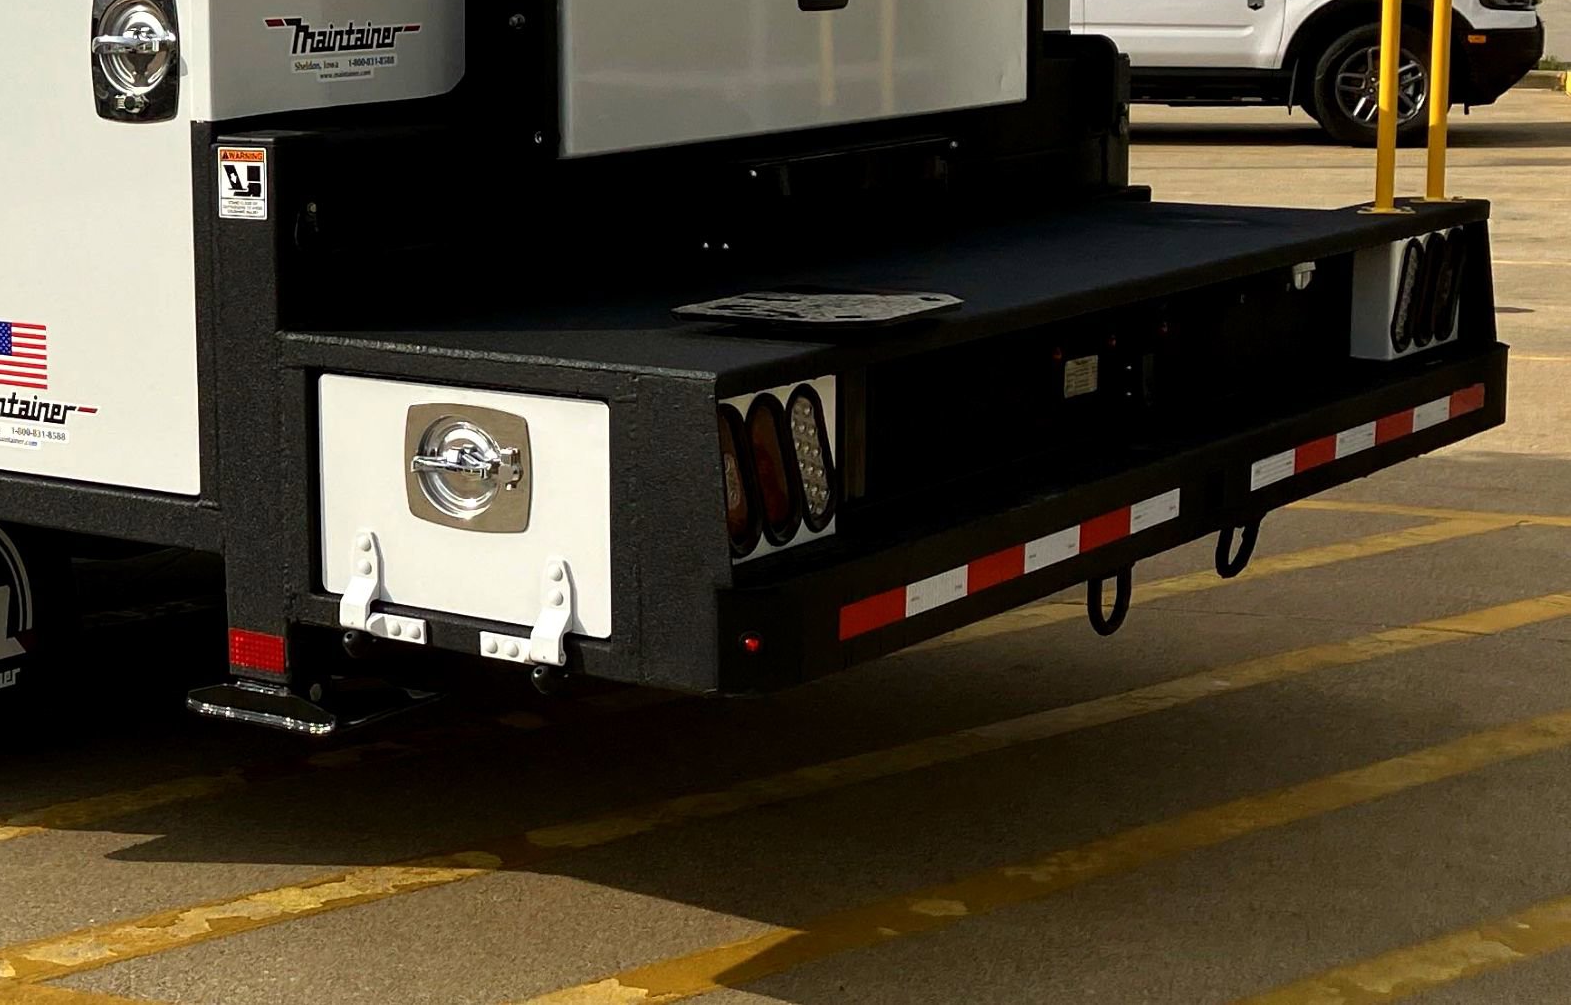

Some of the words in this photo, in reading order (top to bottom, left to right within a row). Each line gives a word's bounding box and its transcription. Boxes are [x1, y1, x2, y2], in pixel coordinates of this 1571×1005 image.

[283, 18, 404, 54] Maintainer
[228, 151, 263, 160] WARNING
[11, 427, 66, 441] 1-800-831-8588
